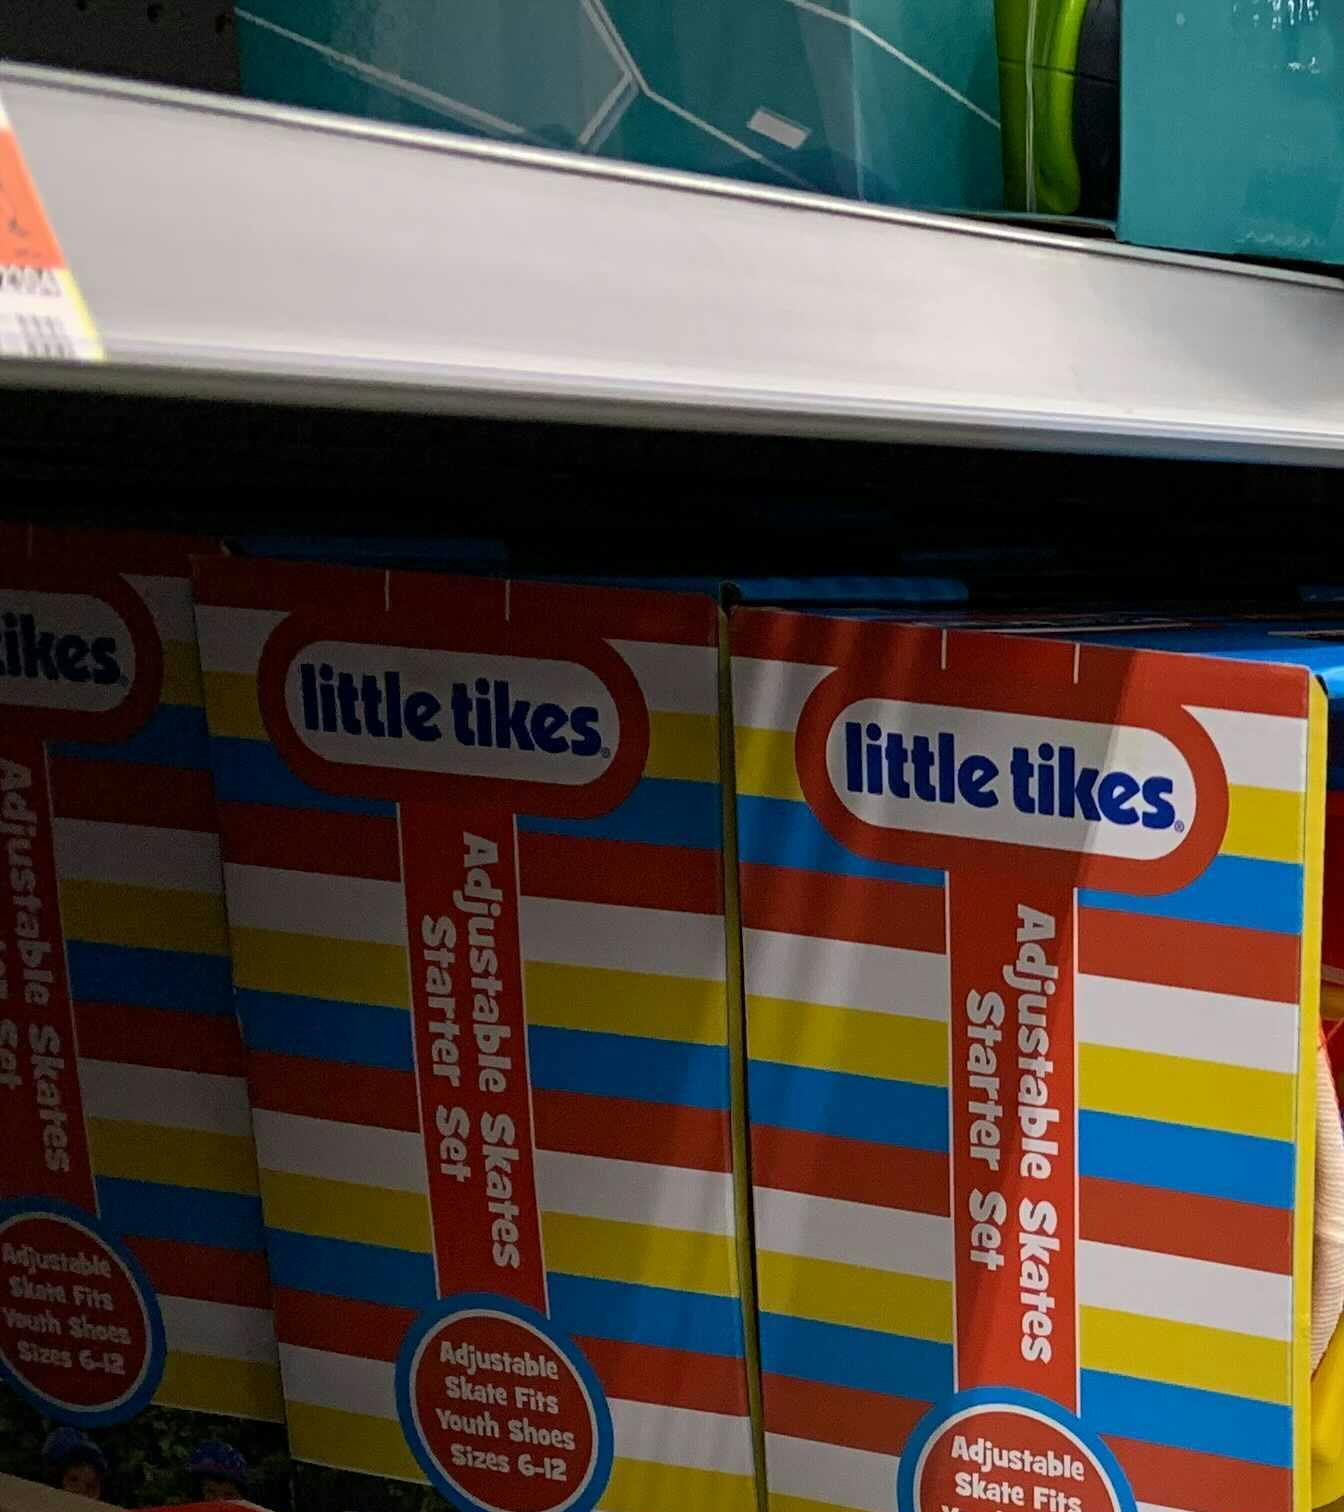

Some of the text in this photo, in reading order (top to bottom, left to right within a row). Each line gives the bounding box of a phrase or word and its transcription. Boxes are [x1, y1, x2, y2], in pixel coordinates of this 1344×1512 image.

[298, 663, 603, 757] little tikes
[845, 721, 1176, 830] little tikes
[421, 914, 470, 1182] Starter Set
[454, 831, 520, 1270] Adjustable Skates
[28, 1022, 71, 1174] Skates
[966, 989, 1005, 1272] Starter Set
[1002, 903, 1060, 1366] Adjustable Skates
[2, 1242, 111, 1278] Adjustable
[10, 1276, 113, 1313] Skate Fits
[2, 1310, 132, 1346] Youth Shoes
[18, 1341, 126, 1376] Sizes 6-12
[440, 1340, 559, 1380] Adjustable
[444, 1374, 559, 1414] Skate Fits
[436, 1409, 576, 1452] Youth Shoes
[451, 1443, 567, 1483] Sizes 6-12
[950, 1433, 1085, 1483] Adjustable
[954, 1473, 1024, 1506] Skate
